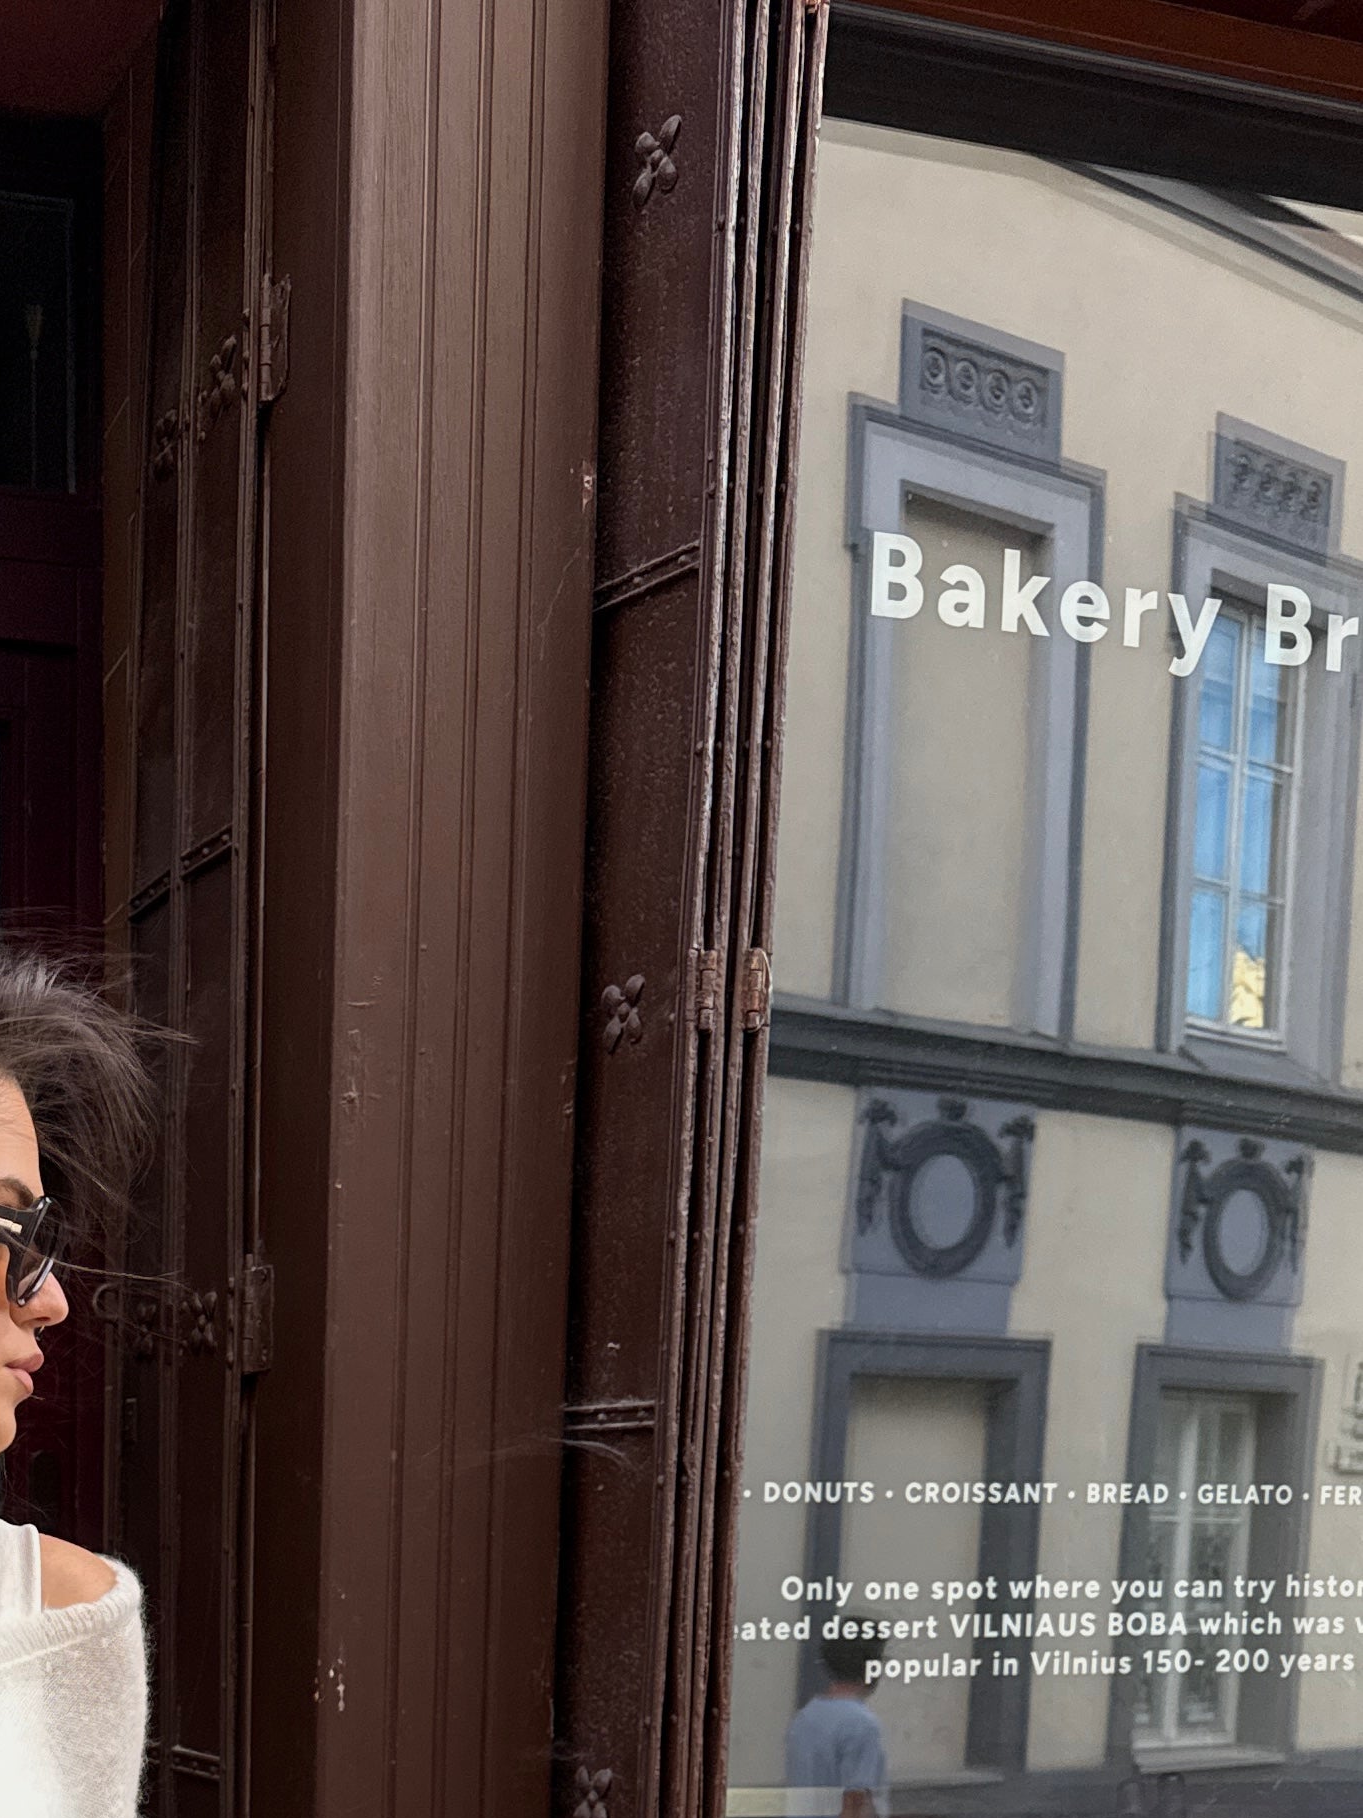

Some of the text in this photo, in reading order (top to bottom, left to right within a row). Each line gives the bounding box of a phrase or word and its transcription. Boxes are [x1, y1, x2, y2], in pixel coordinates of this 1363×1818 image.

[871, 531, 1359, 677] Bakery Br
[764, 1481, 1362, 1505] DONUTS CROISSANT BREAD GELATO FER
[781, 1576, 853, 1607] Only
[865, 1580, 919, 1600] one
[931, 1576, 998, 1606] spot
[1009, 1574, 1100, 1599] where
[1111, 1580, 1163, 1605] you
[1174, 1579, 1223, 1599] can
[1234, 1575, 1276, 1604] try
[822, 1615, 938, 1640] dessert
[950, 1612, 1097, 1638] VILNIAUS
[1108, 1611, 1187, 1637] BOBA
[1199, 1611, 1282, 1635] which
[1293, 1616, 1345, 1634] was
[864, 1648, 1355, 1683] popular in Vilnius 150- 200 years
